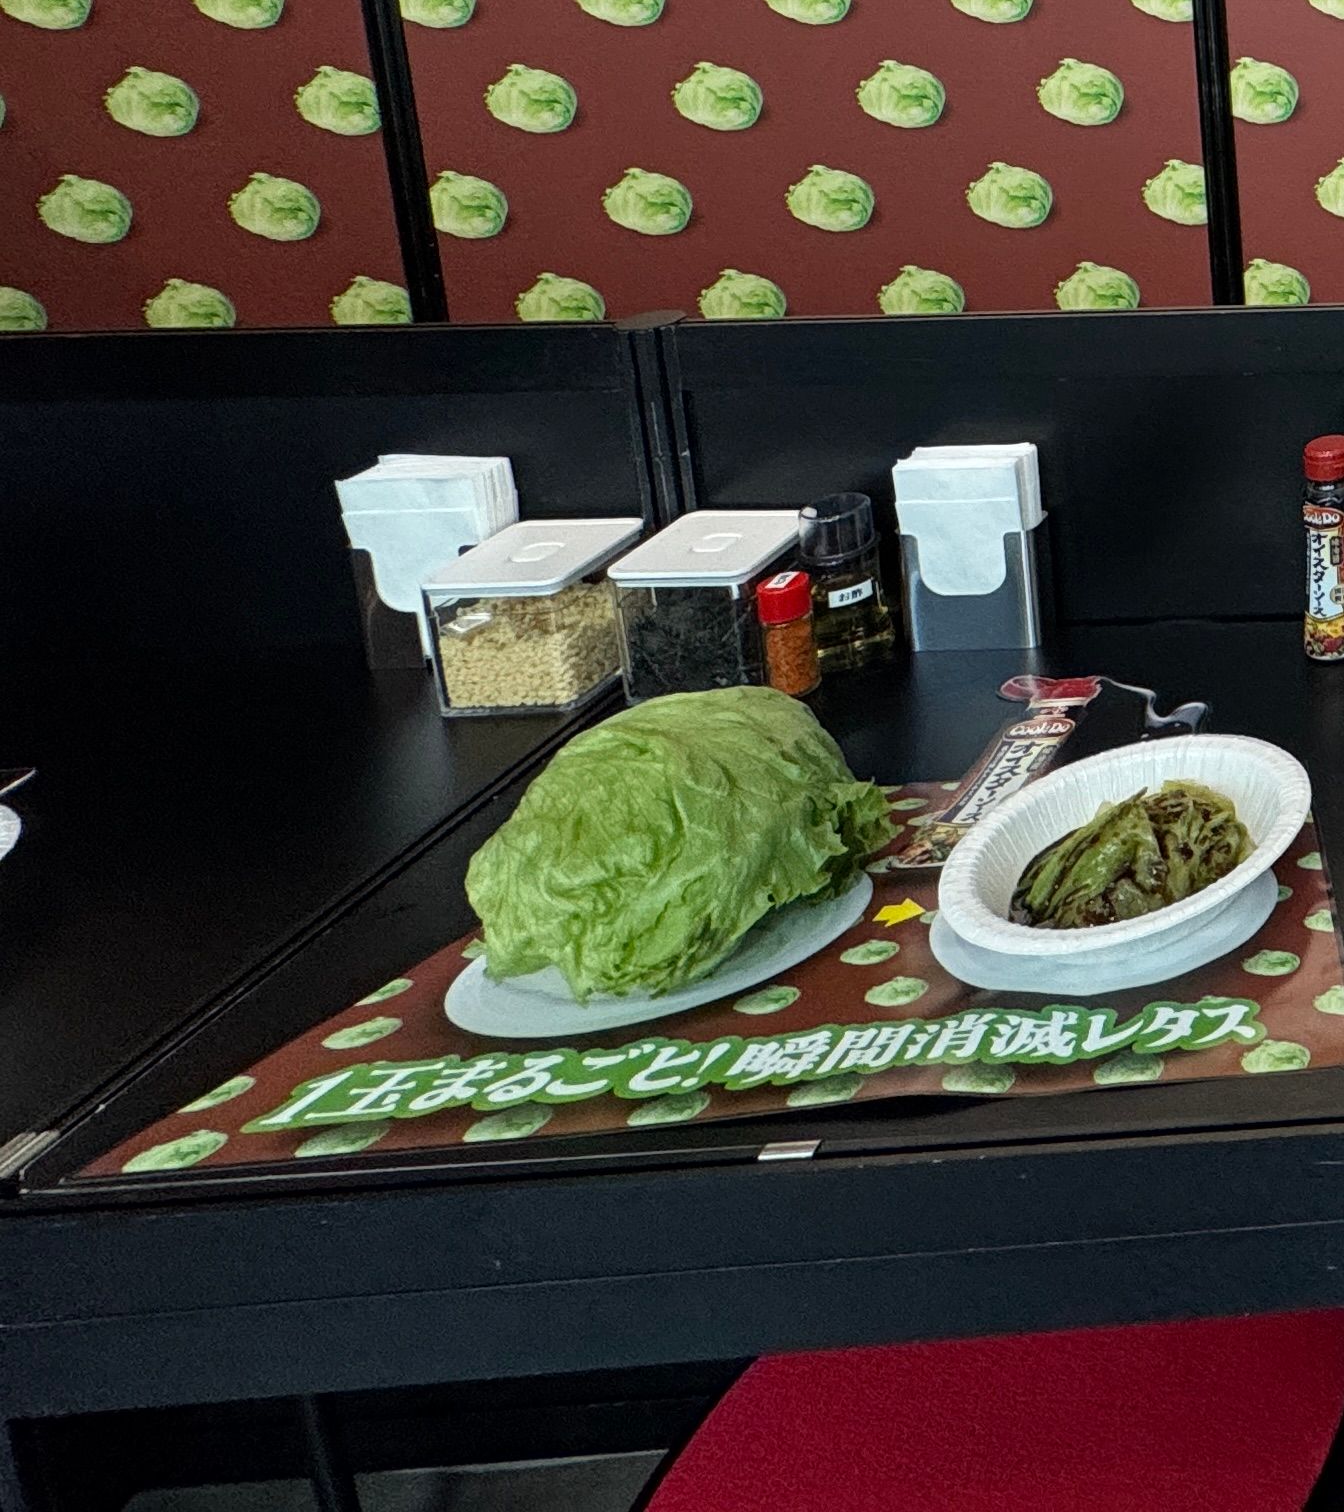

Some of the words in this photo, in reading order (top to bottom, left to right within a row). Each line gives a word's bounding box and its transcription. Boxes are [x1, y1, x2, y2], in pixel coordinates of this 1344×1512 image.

[1311, 532, 1330, 617] オイスターソース
